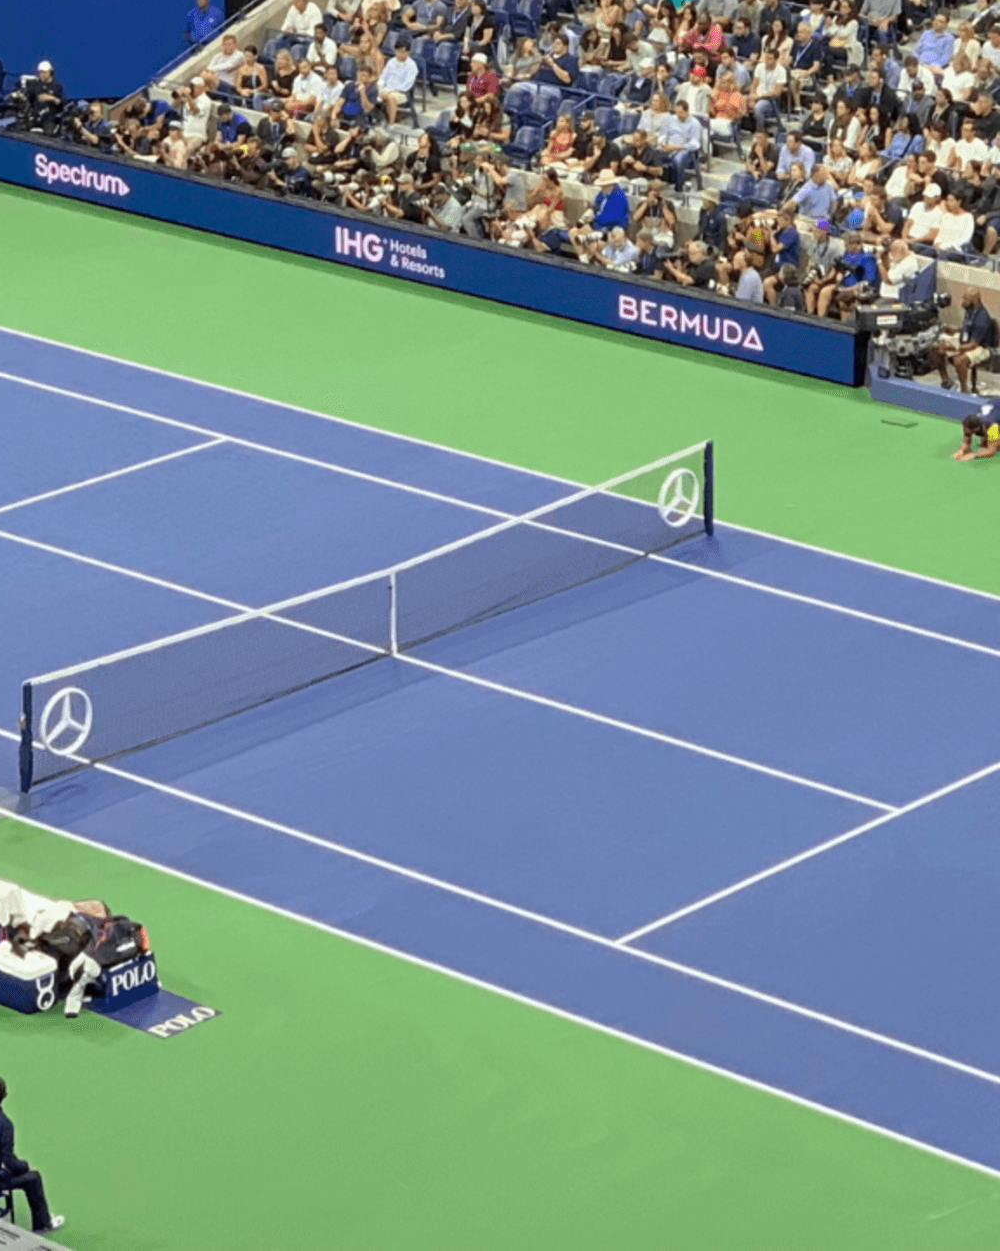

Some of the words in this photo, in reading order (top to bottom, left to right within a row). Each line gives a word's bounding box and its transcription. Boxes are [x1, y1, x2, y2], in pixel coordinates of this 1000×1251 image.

[35, 153, 123, 194] Spectrum
[335, 226, 385, 263] IHG
[390, 238, 428, 260] Hotels
[390, 254, 399, 268] &
[401, 256, 446, 279] Resorts
[618, 294, 765, 352] BERMUDA
[111, 960, 157, 997] POLO
[147, 1005, 217, 1038] POLO
